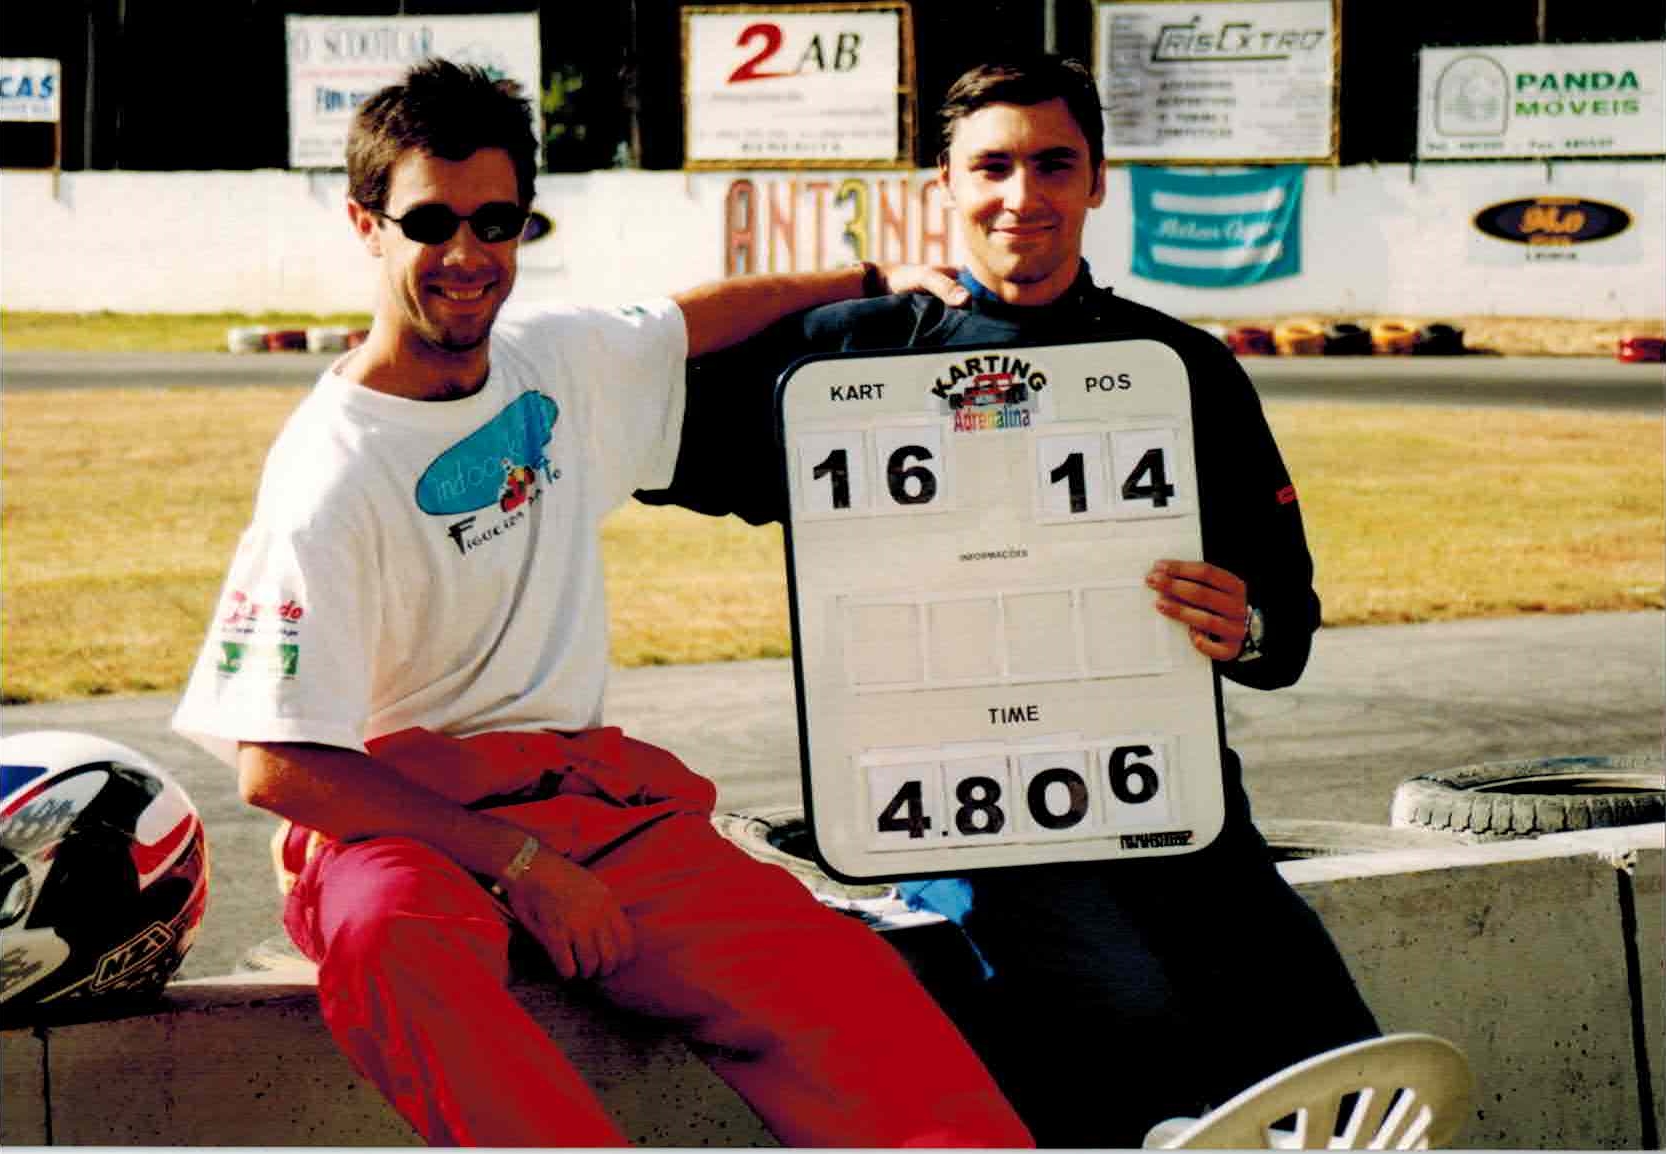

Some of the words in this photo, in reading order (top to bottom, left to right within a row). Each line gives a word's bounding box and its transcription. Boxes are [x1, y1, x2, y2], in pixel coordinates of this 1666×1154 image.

[1516, 71, 1640, 91] PANDA
[931, 355, 1047, 399] KARTING
[1085, 374, 1132, 393] POS
[830, 383, 885, 402] KART
[954, 405, 1032, 432] Adrenalina
[988, 705, 1040, 725] TIME
